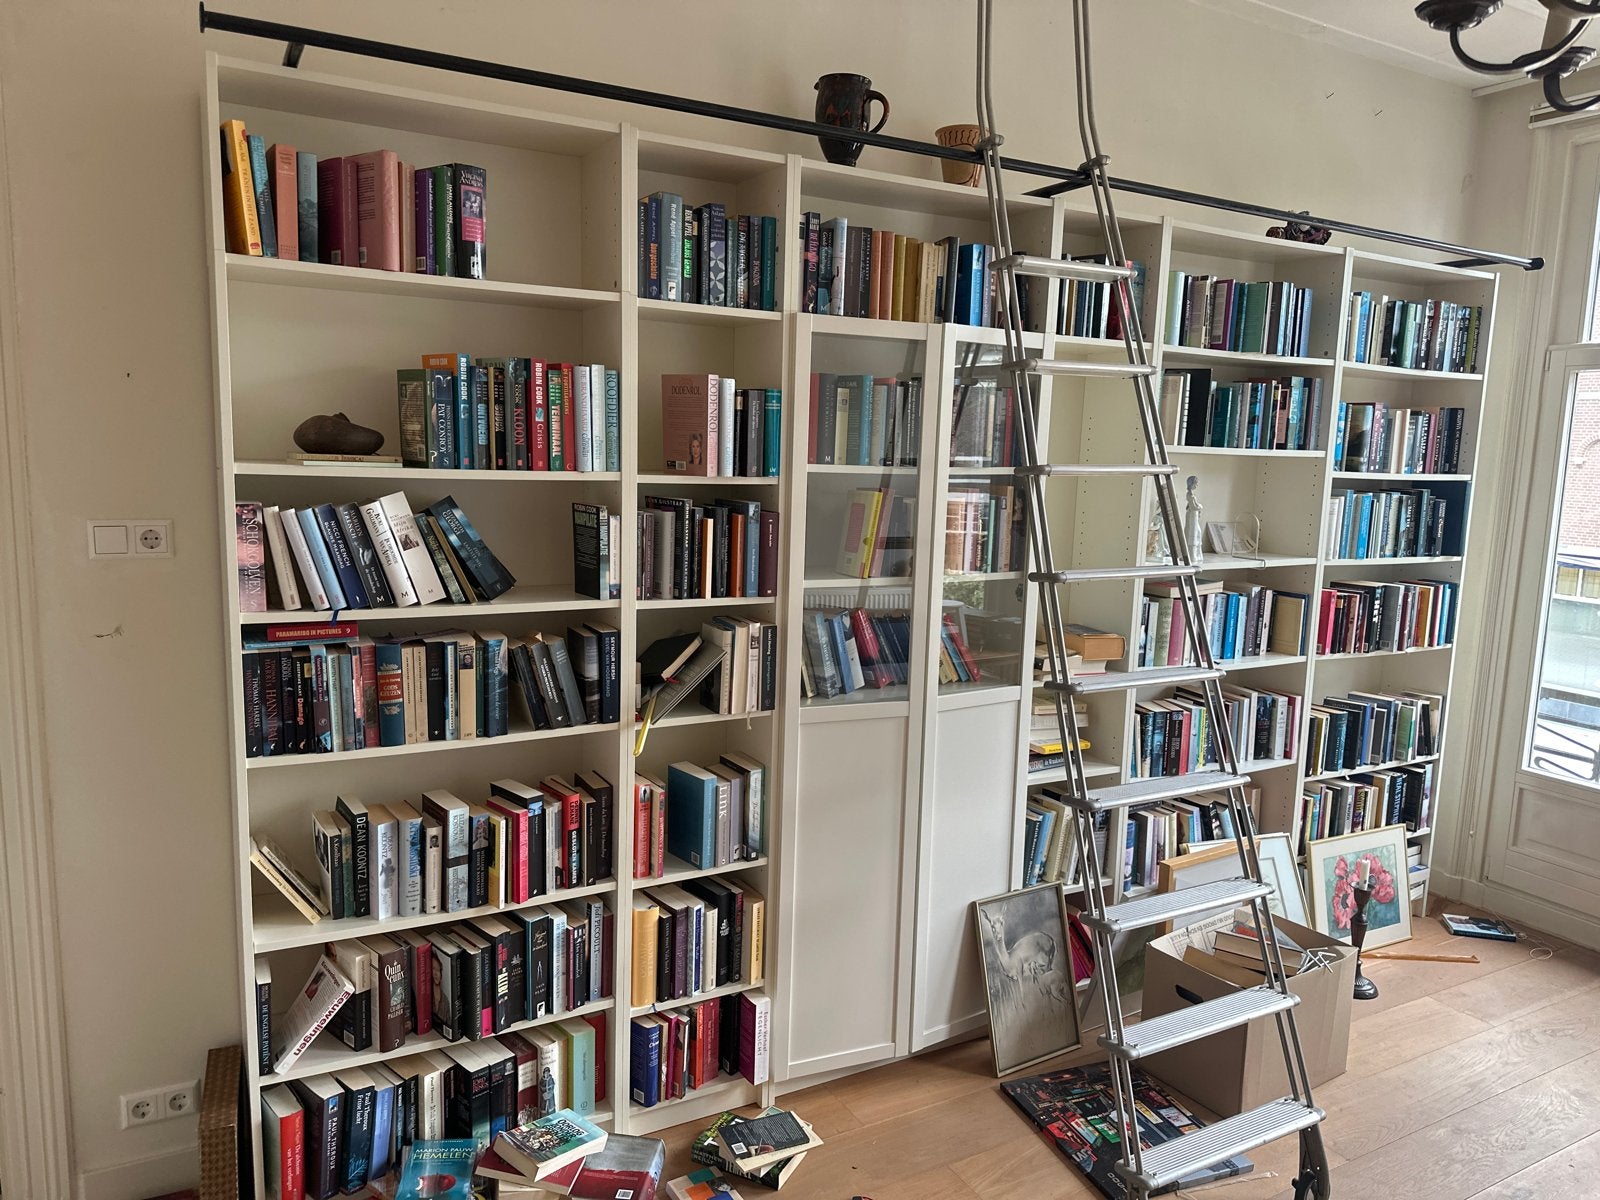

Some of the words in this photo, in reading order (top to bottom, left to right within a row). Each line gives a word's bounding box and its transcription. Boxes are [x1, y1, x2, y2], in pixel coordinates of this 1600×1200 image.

[438, 403, 446, 418] PAT
[606, 373, 617, 428] ROOFDIER
[709, 378, 718, 437] DODENROL
[438, 419, 447, 454] CONROY
[514, 407, 525, 445] KLOON
[552, 405, 561, 457] TERMINAAL
[246, 518, 261, 595] SCHOKGOLVEN
[330, 520, 342, 539] NICCI
[336, 540, 350, 567] FRENCH
[266, 688, 278, 742] HANNIBAL
[356, 816, 366, 841] DEAN
[357, 844, 367, 880] KOONTZ
[262, 1015, 270, 1040] ENGELSE
[293, 990, 351, 1057] Eeuwelingen
[413, 1152, 474, 1160] HEMELEN
